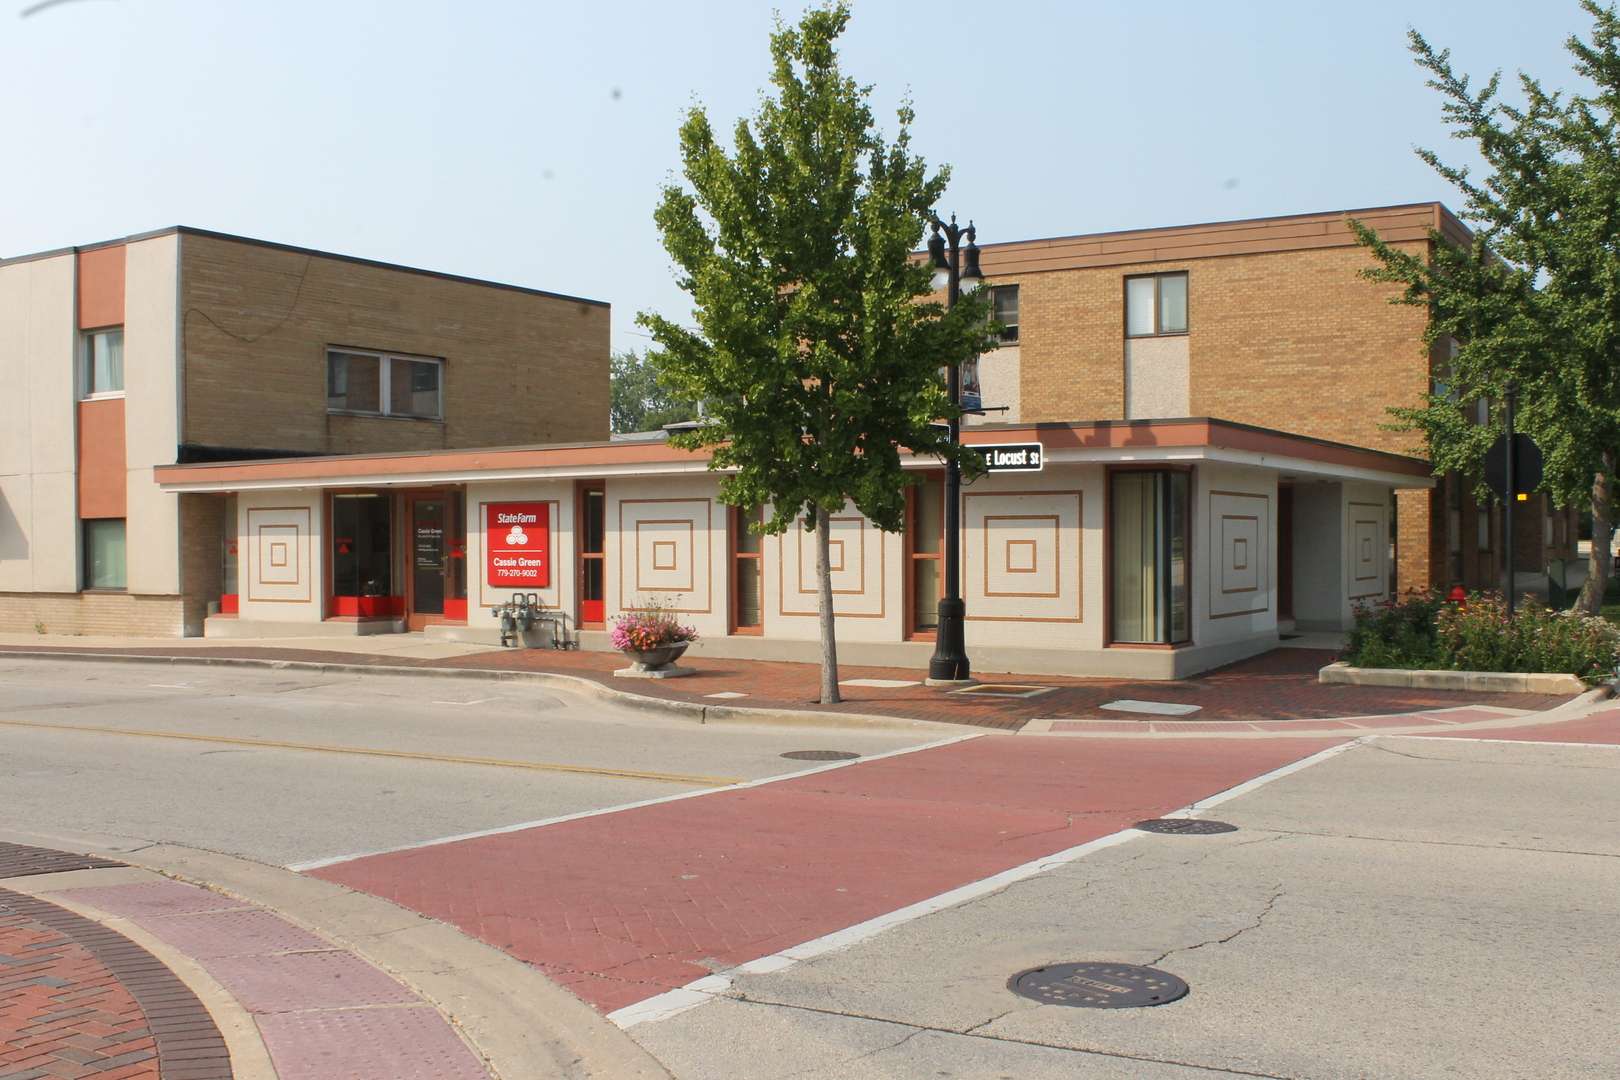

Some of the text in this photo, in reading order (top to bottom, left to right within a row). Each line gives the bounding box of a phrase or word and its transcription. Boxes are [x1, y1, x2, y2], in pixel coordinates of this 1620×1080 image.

[994, 450, 1026, 465] Locust
[1030, 452, 1040, 464] St
[493, 557, 541, 567] Cassie Green
